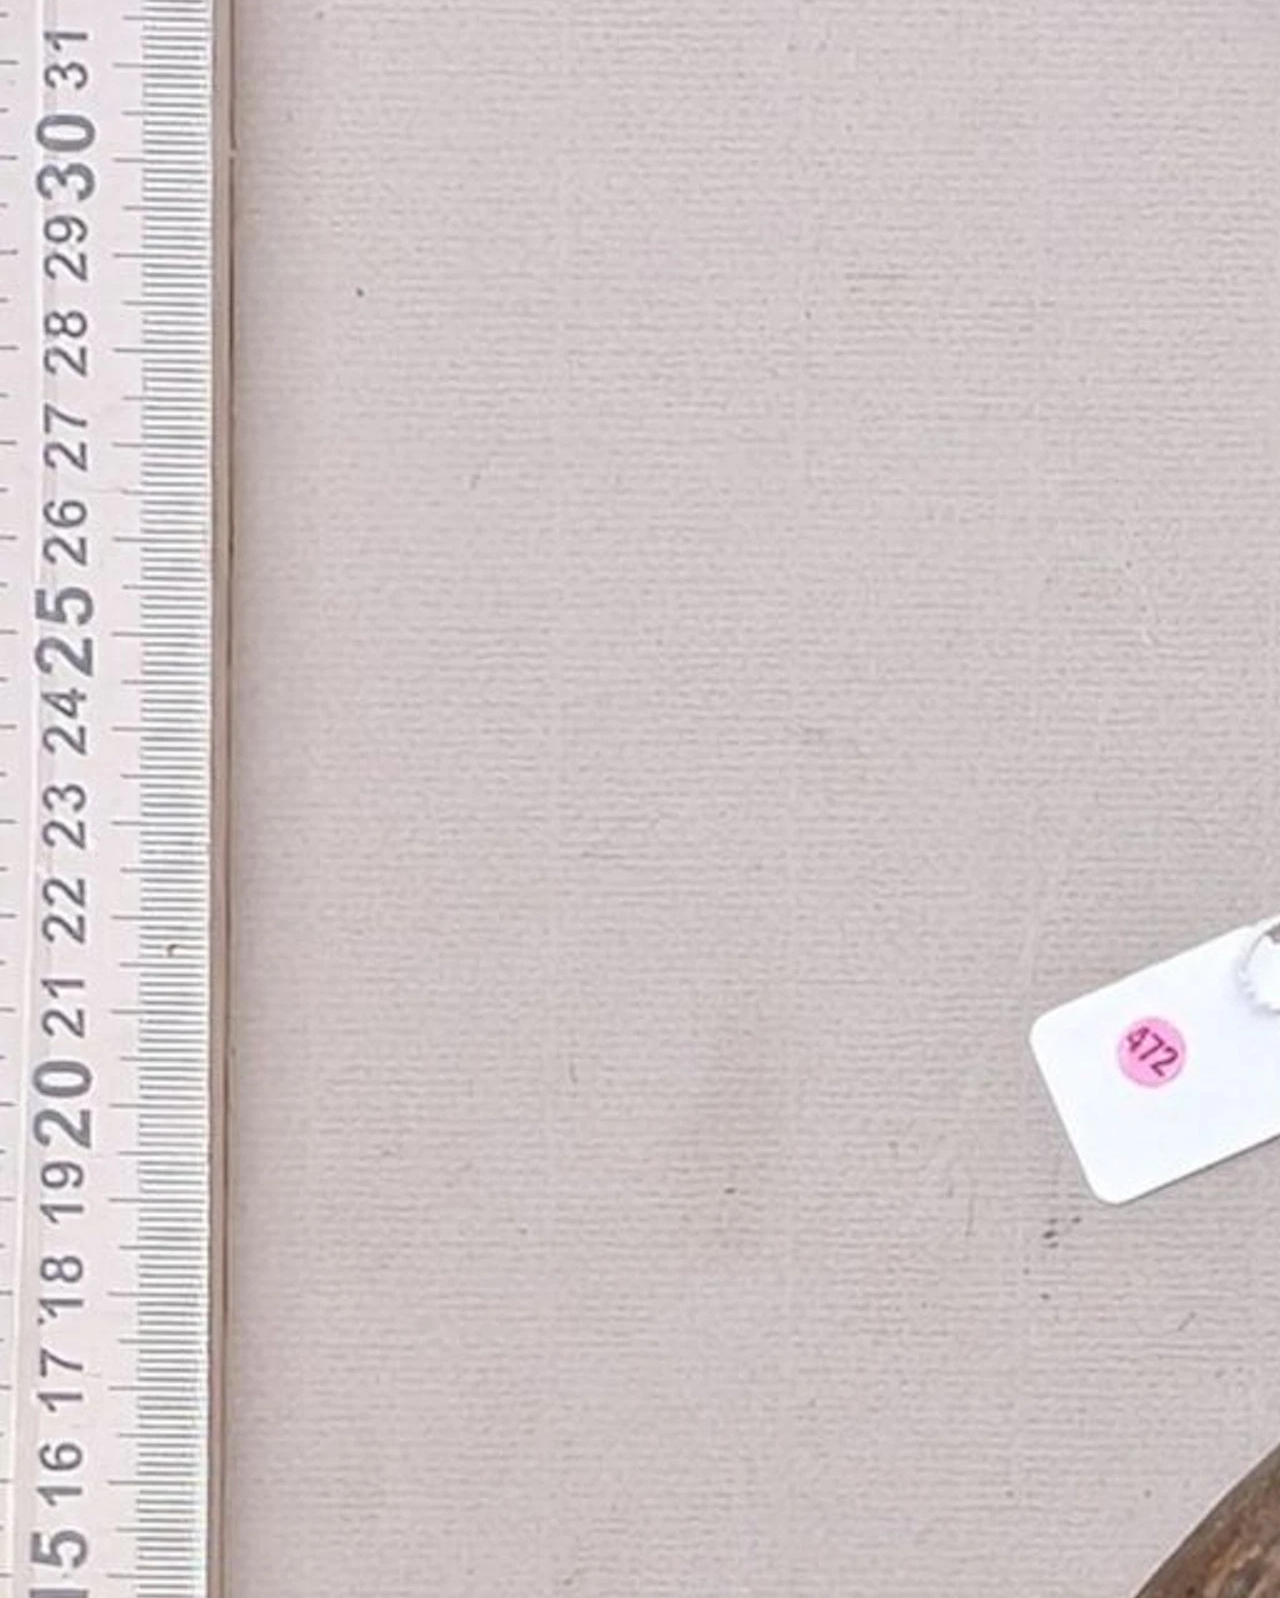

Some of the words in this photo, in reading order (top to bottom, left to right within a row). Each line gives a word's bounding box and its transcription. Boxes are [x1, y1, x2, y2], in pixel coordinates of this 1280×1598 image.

[42, 30, 89, 91] 31
[35, 114, 96, 203] 30
[42, 214, 89, 282] 29
[42, 310, 88, 378] 28
[42, 402, 88, 472] 27
[42, 499, 88, 567] 26
[33, 586, 94, 677] 25
[40, 687, 88, 756] 24
[40, 783, 87, 850] 23
[40, 877, 86, 945] 22
[40, 978, 85, 1039] 21
[1126, 1026, 1179, 1077] 472
[31, 1060, 93, 1150] 20
[38, 1161, 85, 1224] 19
[37, 1255, 85, 1315] 18
[36, 1348, 84, 1413] 17
[35, 1442, 83, 1507] 16
